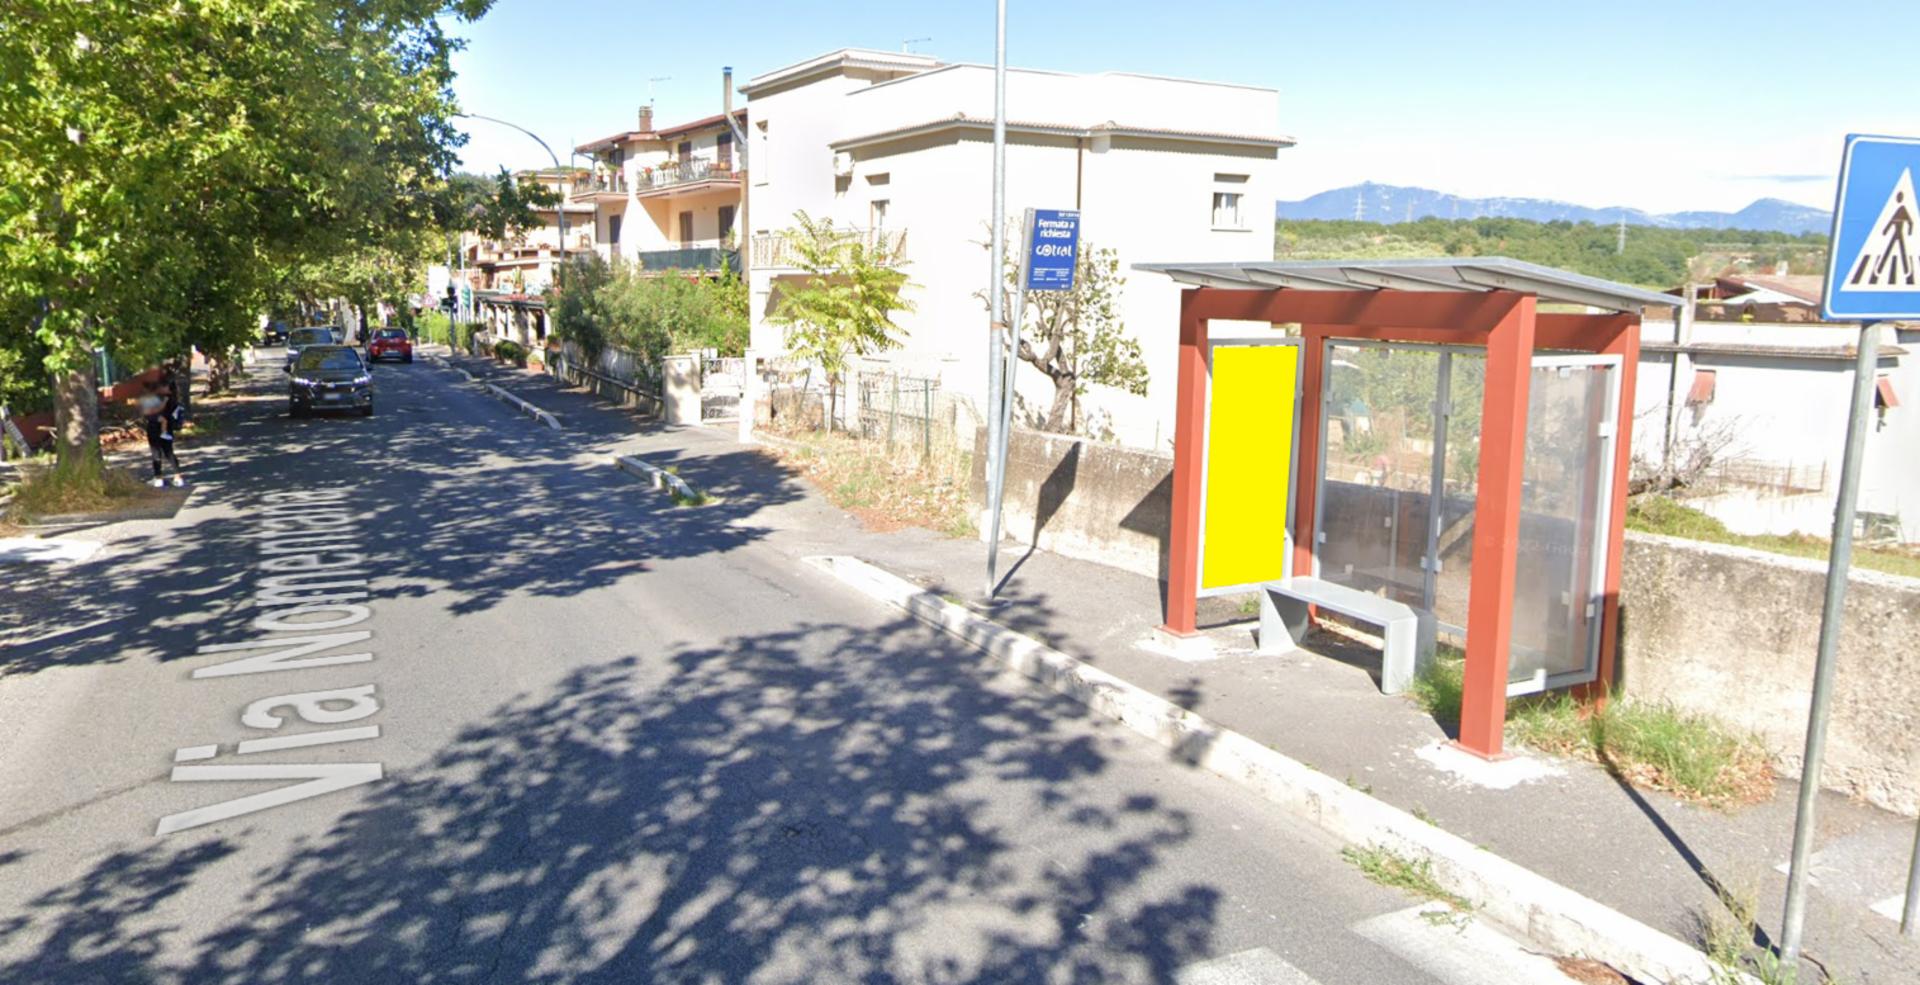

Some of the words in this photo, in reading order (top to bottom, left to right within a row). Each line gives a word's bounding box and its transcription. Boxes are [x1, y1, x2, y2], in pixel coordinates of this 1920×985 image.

[1038, 218, 1069, 228] Fermata
[1070, 221, 1075, 229] a
[1040, 229, 1071, 238] richiesta
